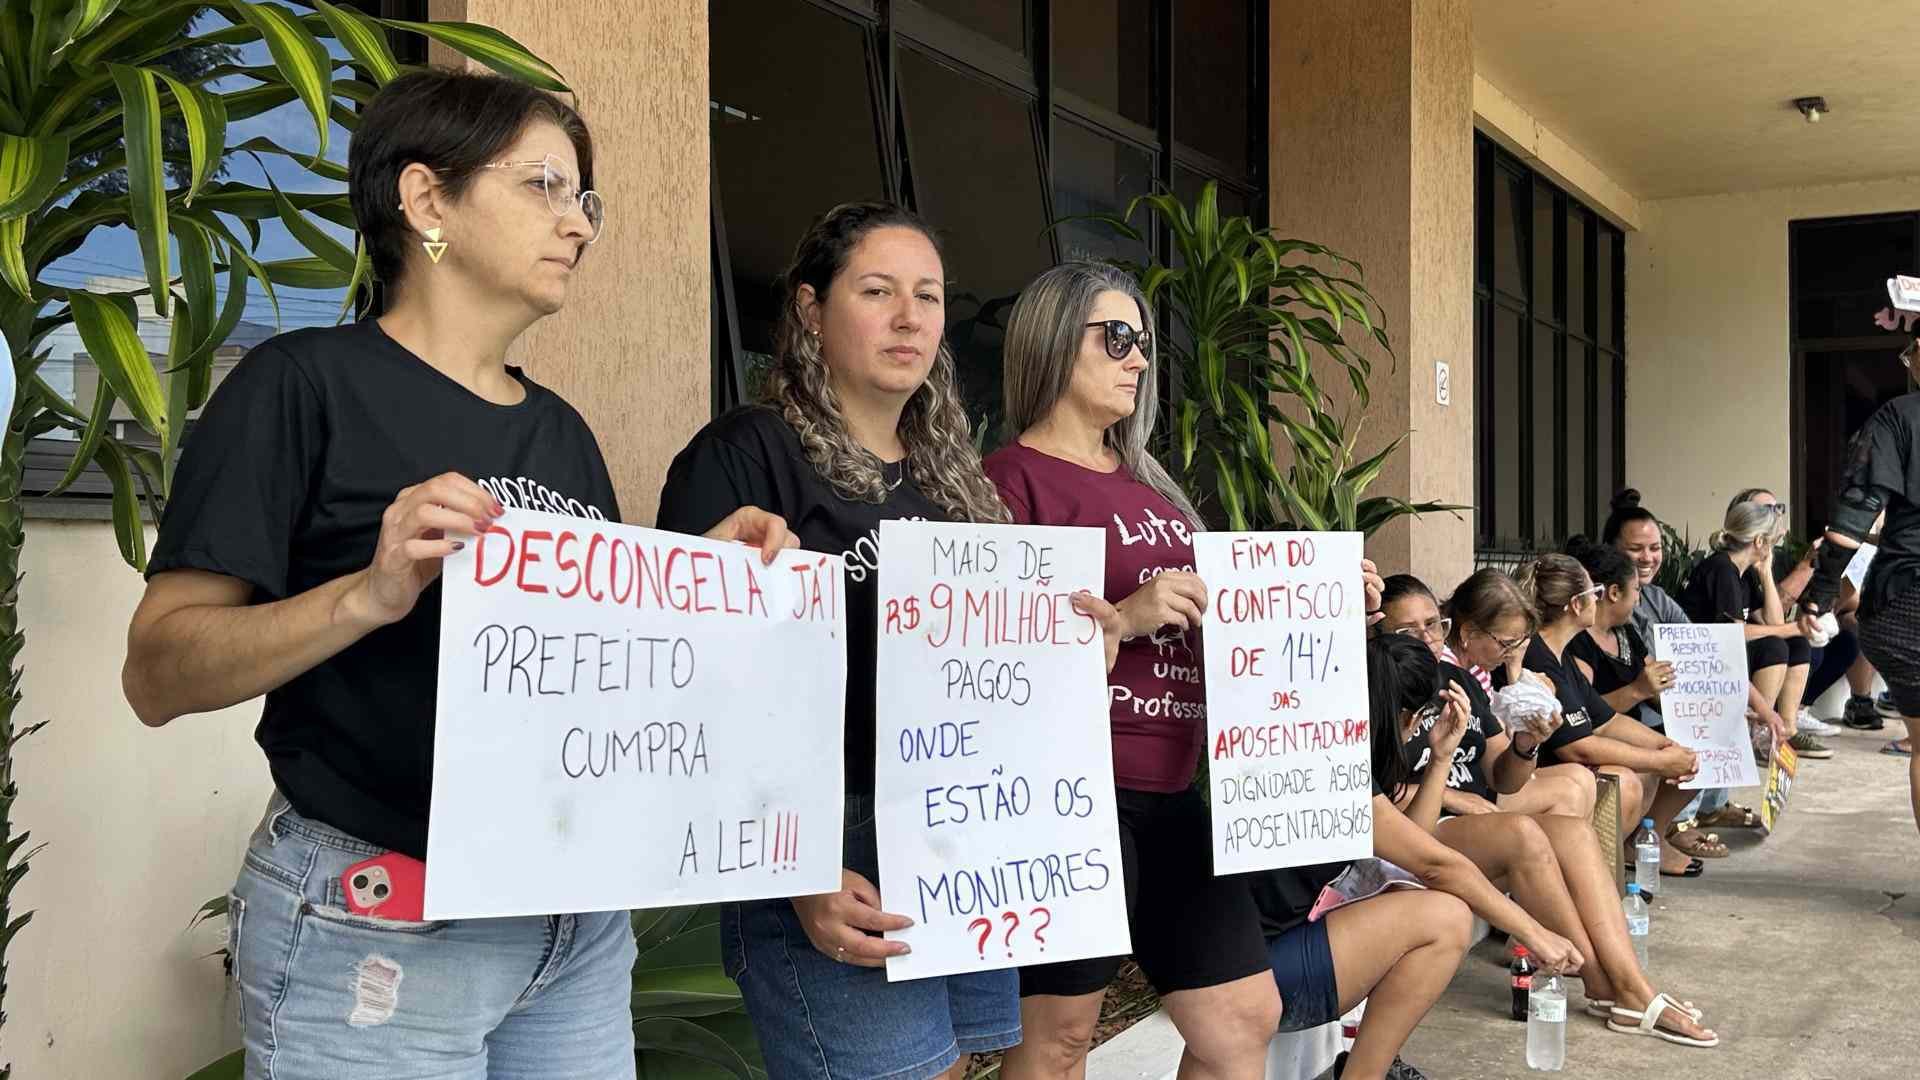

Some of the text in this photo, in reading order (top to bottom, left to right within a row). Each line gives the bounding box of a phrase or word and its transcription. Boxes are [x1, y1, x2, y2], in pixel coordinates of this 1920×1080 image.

[931, 535, 1055, 581] MAIS DE
[1139, 564, 1194, 585] coo
[1232, 536, 1315, 571] FIM DO
[474, 526, 837, 639] DESCONGELA JÁ!
[1217, 581, 1344, 624] CONFISCO
[885, 577, 1097, 649] R$ 9 MILHÕES
[474, 623, 695, 697] PREFEITO
[941, 658, 1032, 706] PAGOS
[1153, 661, 1201, 684] uma
[1232, 647, 1265, 678] DE
[1270, 690, 1302, 711] DAS
[562, 722, 709, 779] CUMPRA
[899, 720, 980, 763] ONDE
[925, 763, 1094, 828] ESTÃO OS
[1222, 767, 1315, 806] DIGNIDADE
[678, 801, 800, 877] A LEI!!!
[917, 847, 1110, 924] MONITORES
